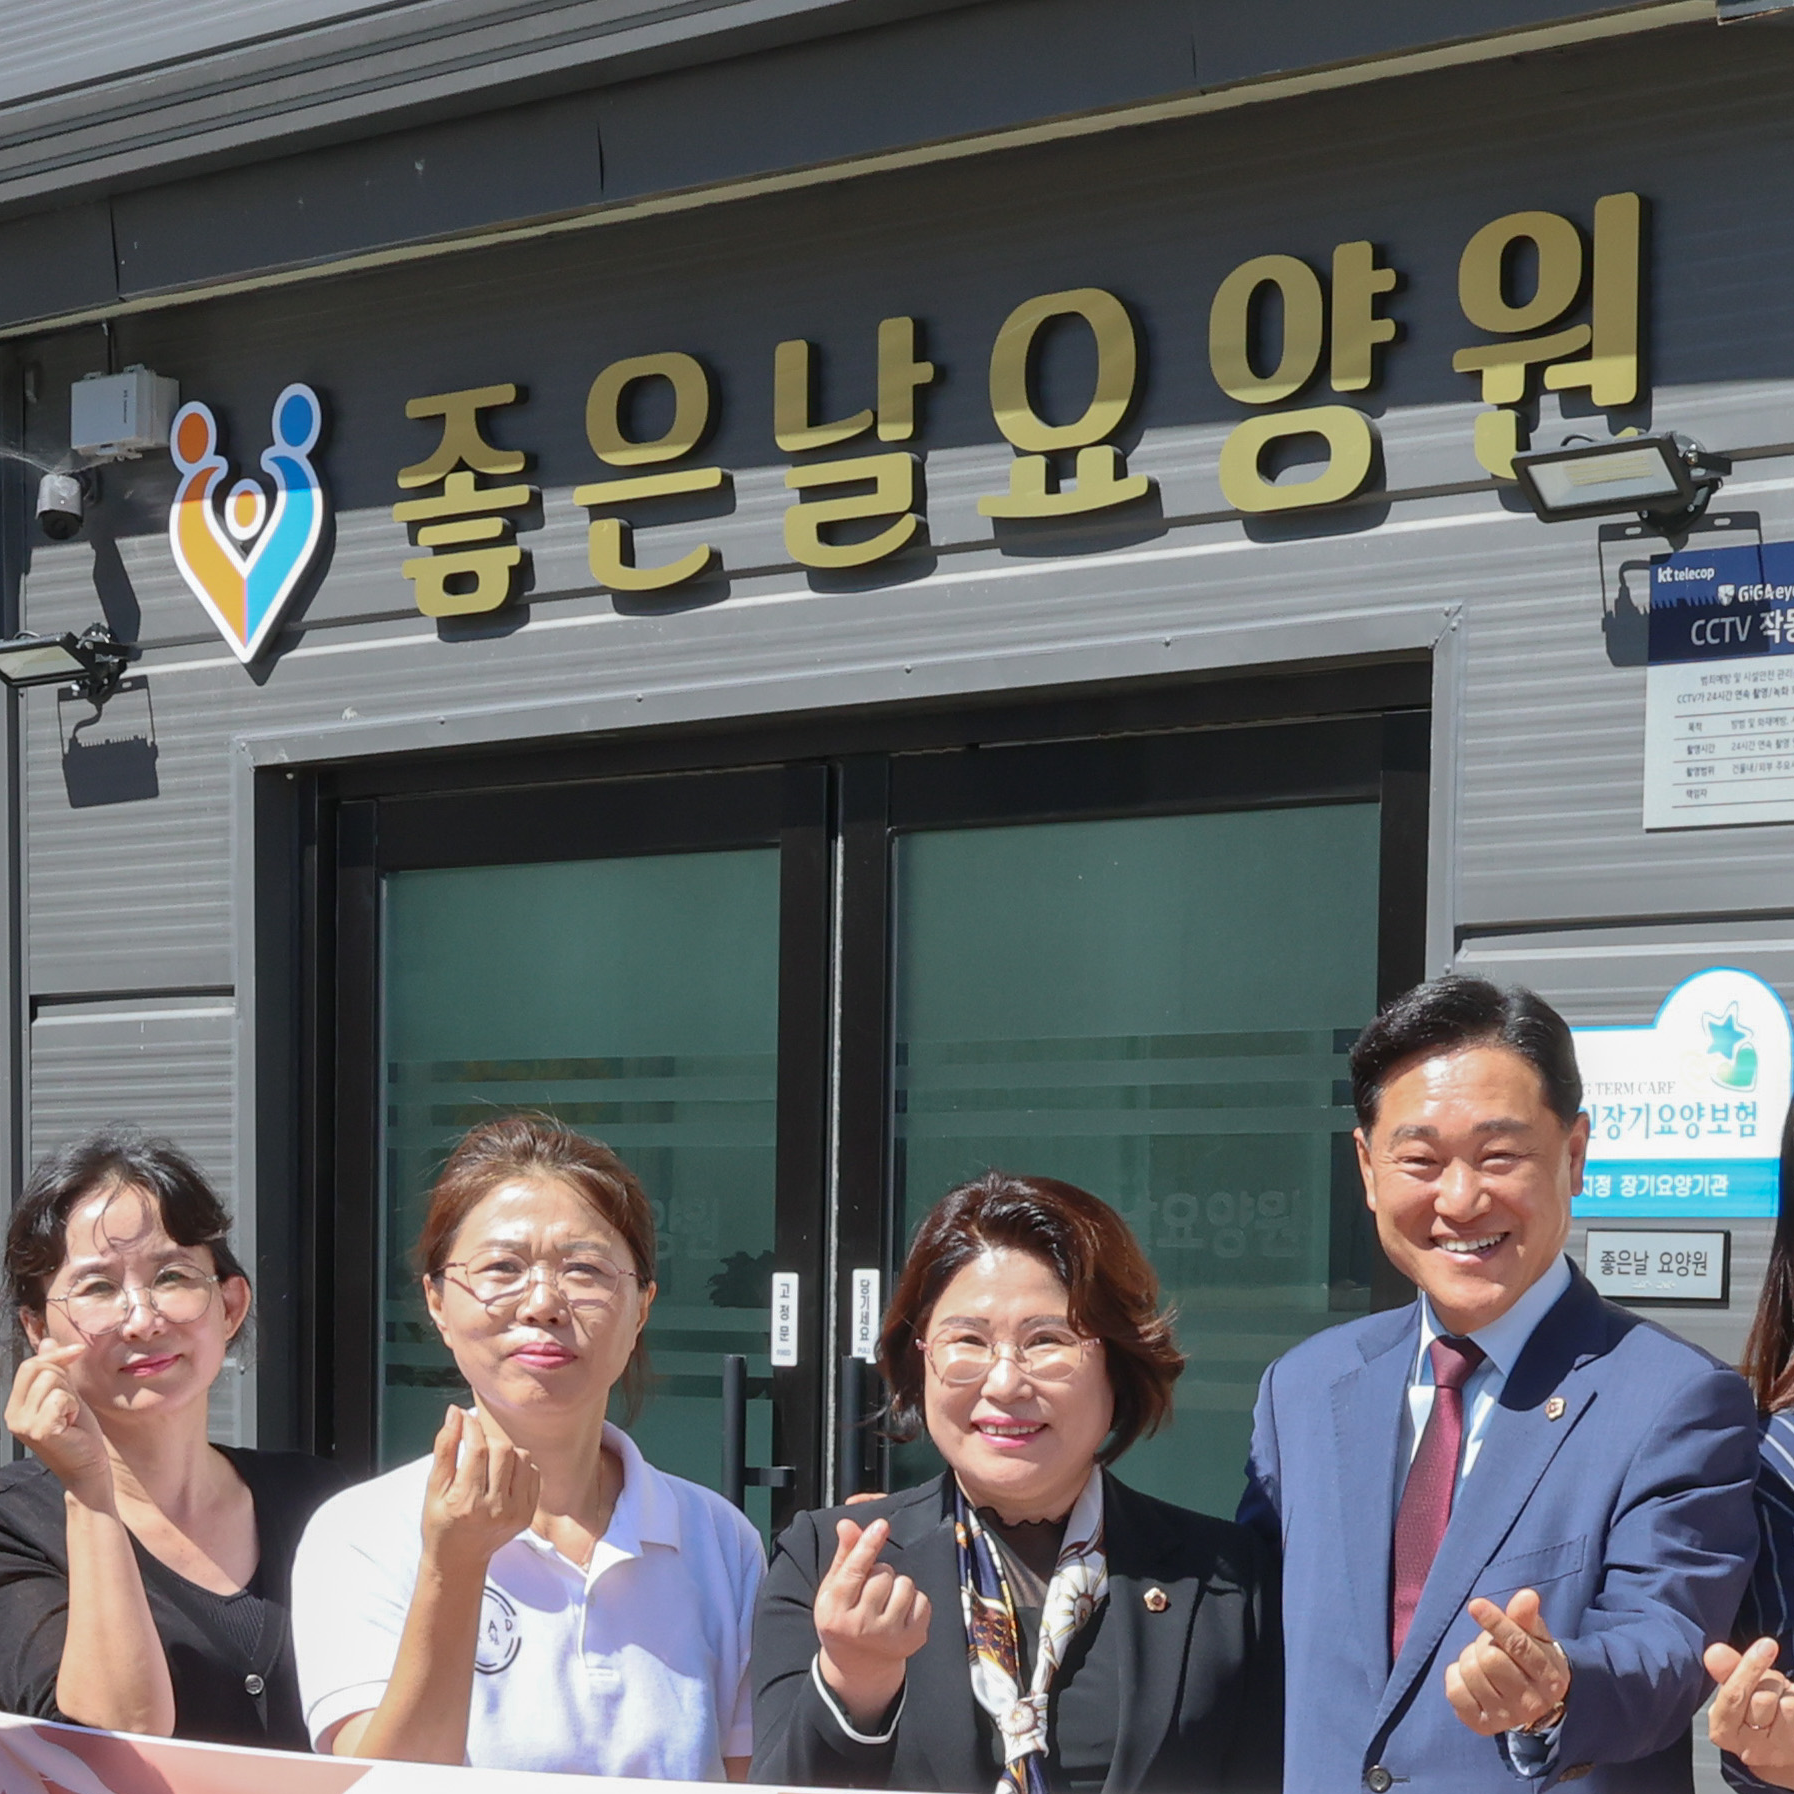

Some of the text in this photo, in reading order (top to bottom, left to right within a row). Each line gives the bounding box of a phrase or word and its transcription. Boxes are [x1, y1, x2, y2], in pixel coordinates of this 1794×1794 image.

[392, 191, 1640, 618] 좋은날요양원
[1657, 566, 1715, 583] kt telecop
[1691, 615, 1752, 646] CCTV
[1700, 673, 1732, 687] 범죄예방
[1733, 672, 1741, 684] 및
[1743, 669, 1776, 683] 시설안전
[1676, 691, 1705, 704] CCTV가
[1706, 689, 1733, 702] 24시간
[1734, 688, 1750, 700] 연속
[1752, 684, 1789, 700] 촬영/녹화
[1748, 718, 1755, 729] 및
[1731, 740, 1756, 752] 24시간
[1757, 739, 1772, 750] 연속
[1775, 737, 1790, 749] 촬영
[1595, 1081, 1634, 1096] TERM
[1620, 1173, 1729, 1198] 장기요양기관
[1600, 1249, 1707, 1277] 좋은날 요양원
[779, 1283, 790, 1342] 고정문
[859, 1279, 871, 1341] 당기세요
